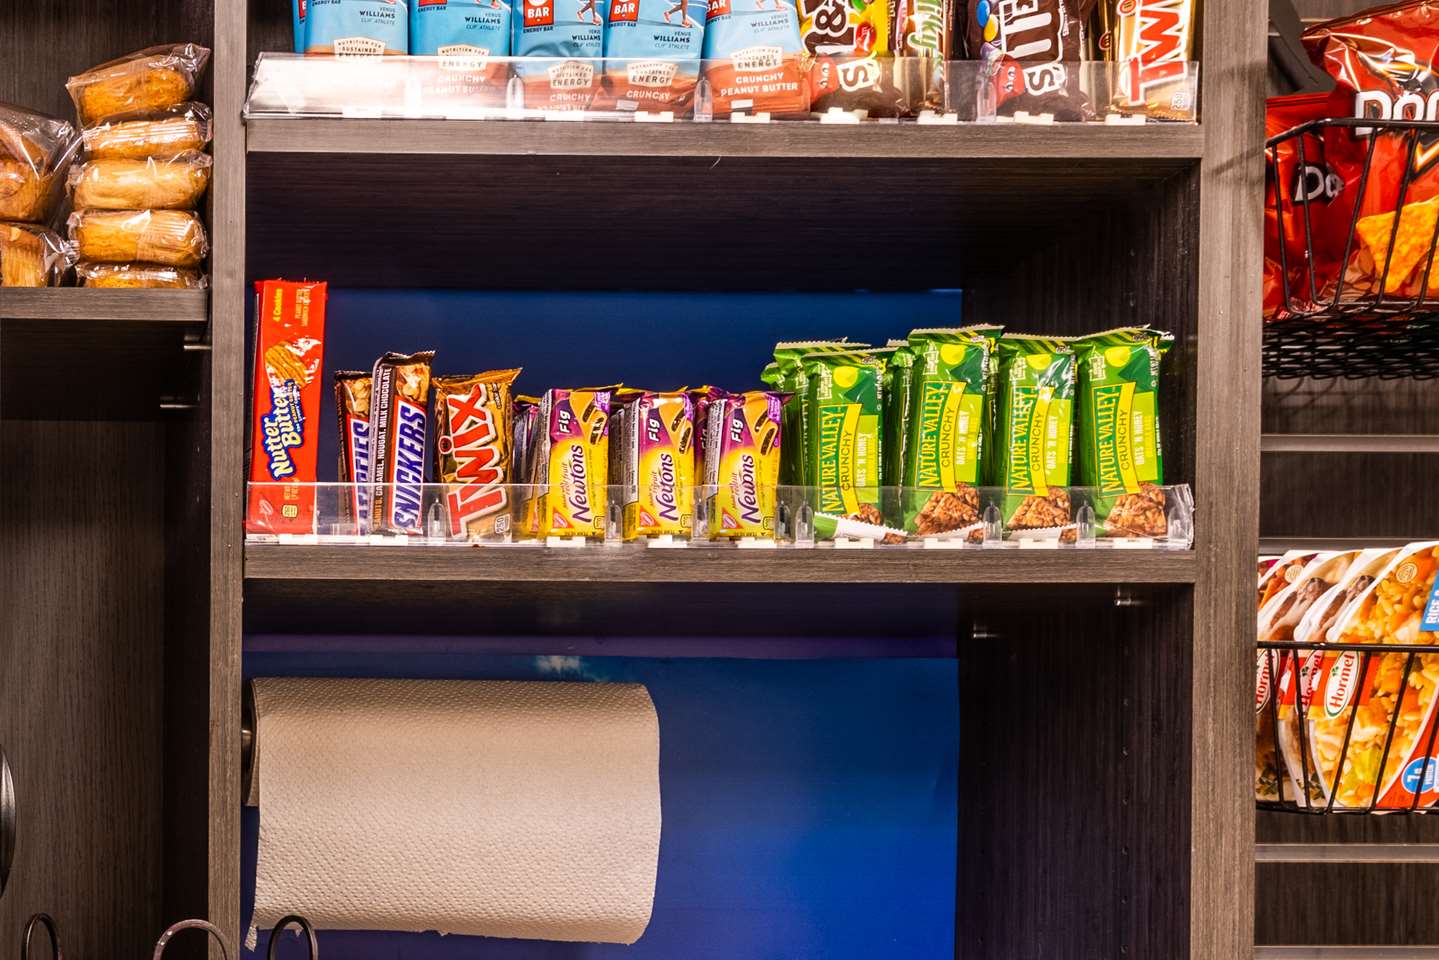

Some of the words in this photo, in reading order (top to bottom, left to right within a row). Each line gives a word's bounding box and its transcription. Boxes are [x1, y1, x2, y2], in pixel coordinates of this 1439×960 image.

[360, 10, 395, 19] WILLIAMS
[465, 16, 501, 24] WILLIAMS
[527, 8, 550, 18] BAR
[614, 4, 635, 14] BAR
[721, 85, 760, 97] PEANUT
[762, 82, 799, 93] BUTTER
[735, 72, 784, 84] CRUNCHY
[273, 387, 302, 447] Butter
[560, 411, 570, 433] Fig
[649, 419, 660, 442] Fig
[730, 418, 742, 442] Fig
[822, 407, 845, 458] VALLEY
[924, 384, 948, 433] VALLEY
[1097, 389, 1120, 439] VALLEY
[263, 417, 294, 478] Nutter
[447, 384, 506, 538] TWIX
[841, 431, 852, 491] CRUNCHY
[919, 433, 941, 487] NATURE
[942, 407, 955, 468] CRUNCHY
[1011, 437, 1034, 491] NATURE
[1032, 413, 1044, 471] CRUNCHY
[394, 405, 427, 528] SNICKERS
[569, 444, 592, 522] Newtons
[822, 458, 844, 512] NATURE
[1100, 440, 1123, 493] NATURE
[1329, 654, 1355, 708] Hormel
